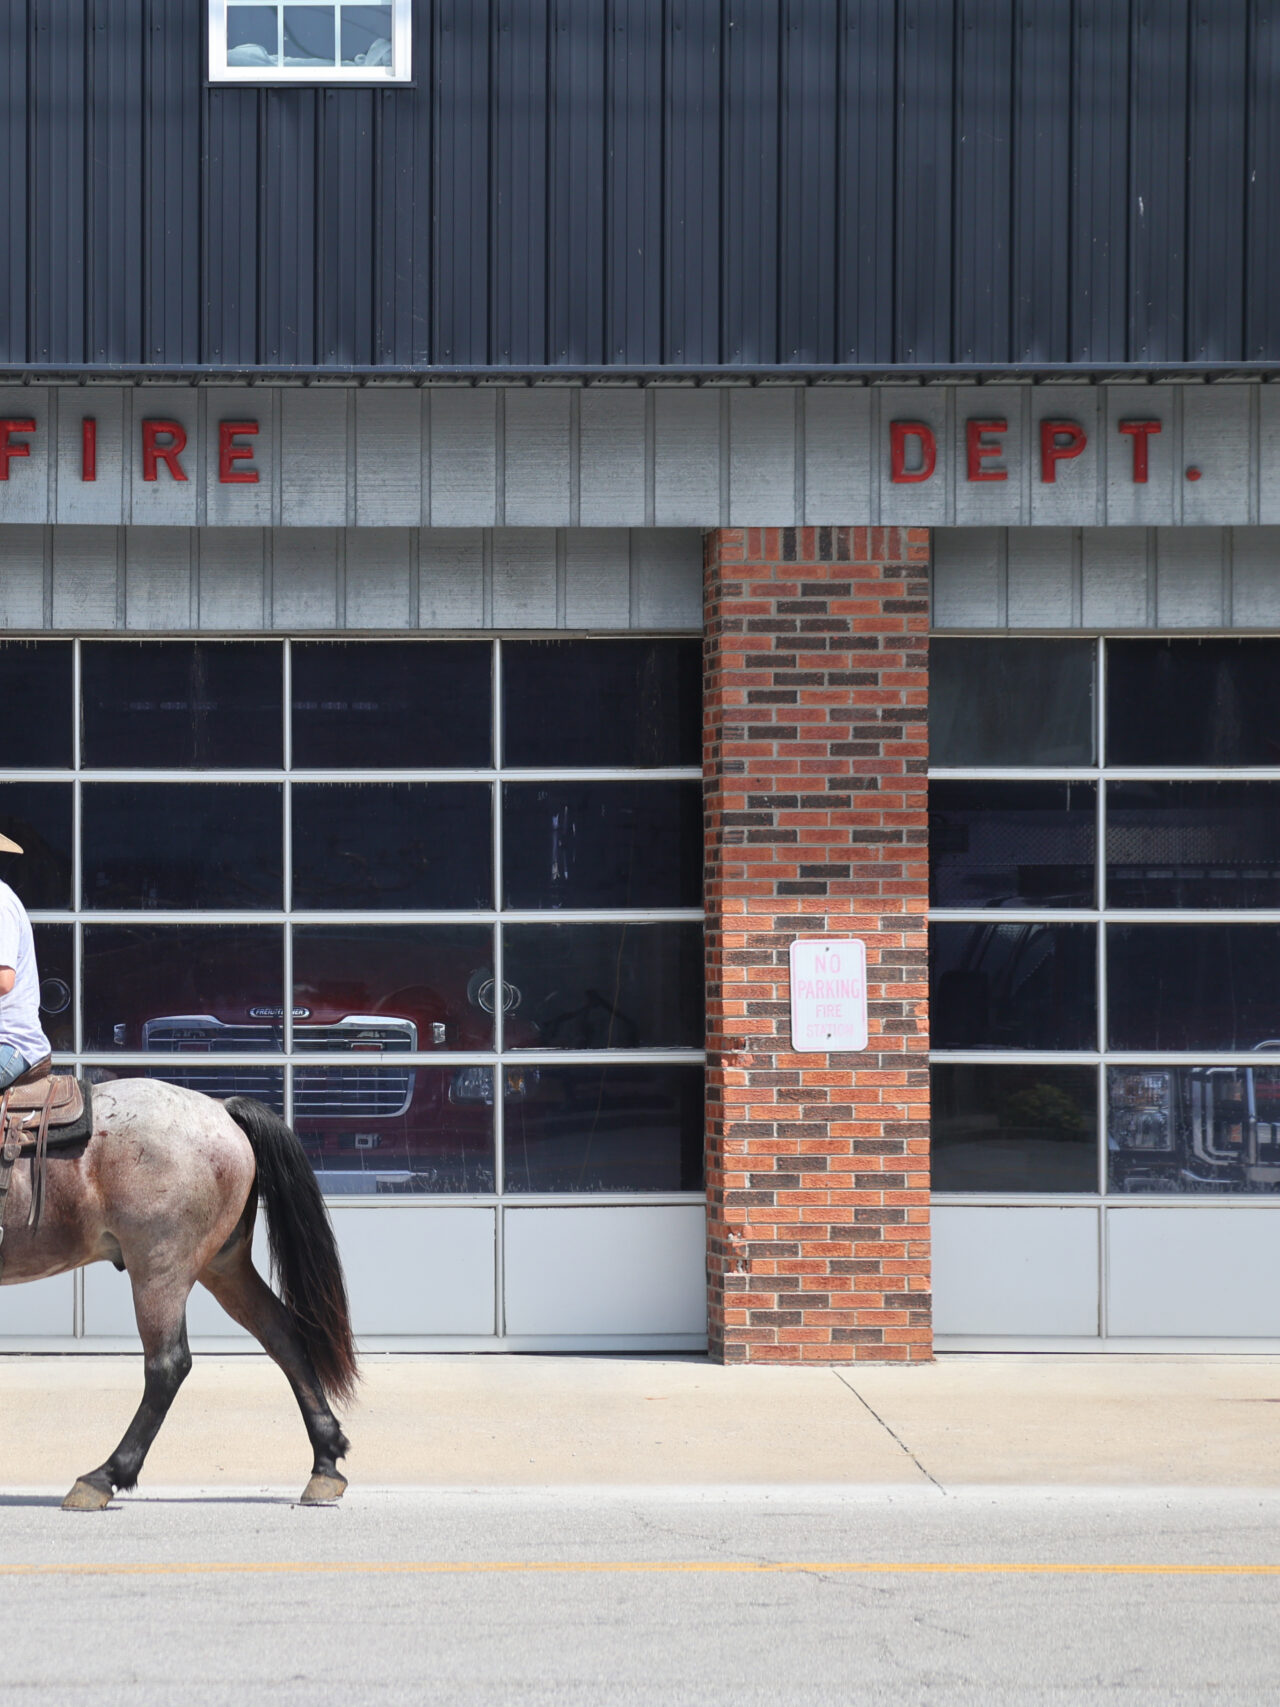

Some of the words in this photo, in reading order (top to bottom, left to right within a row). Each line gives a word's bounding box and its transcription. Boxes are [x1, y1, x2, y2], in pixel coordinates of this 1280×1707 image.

[890, 418, 1202, 483] DEPT.
[815, 954, 841, 974] NO
[798, 979, 860, 1000] PARKING
[816, 1004, 842, 1018] FIRE
[806, 1023, 854, 1038] STATION
